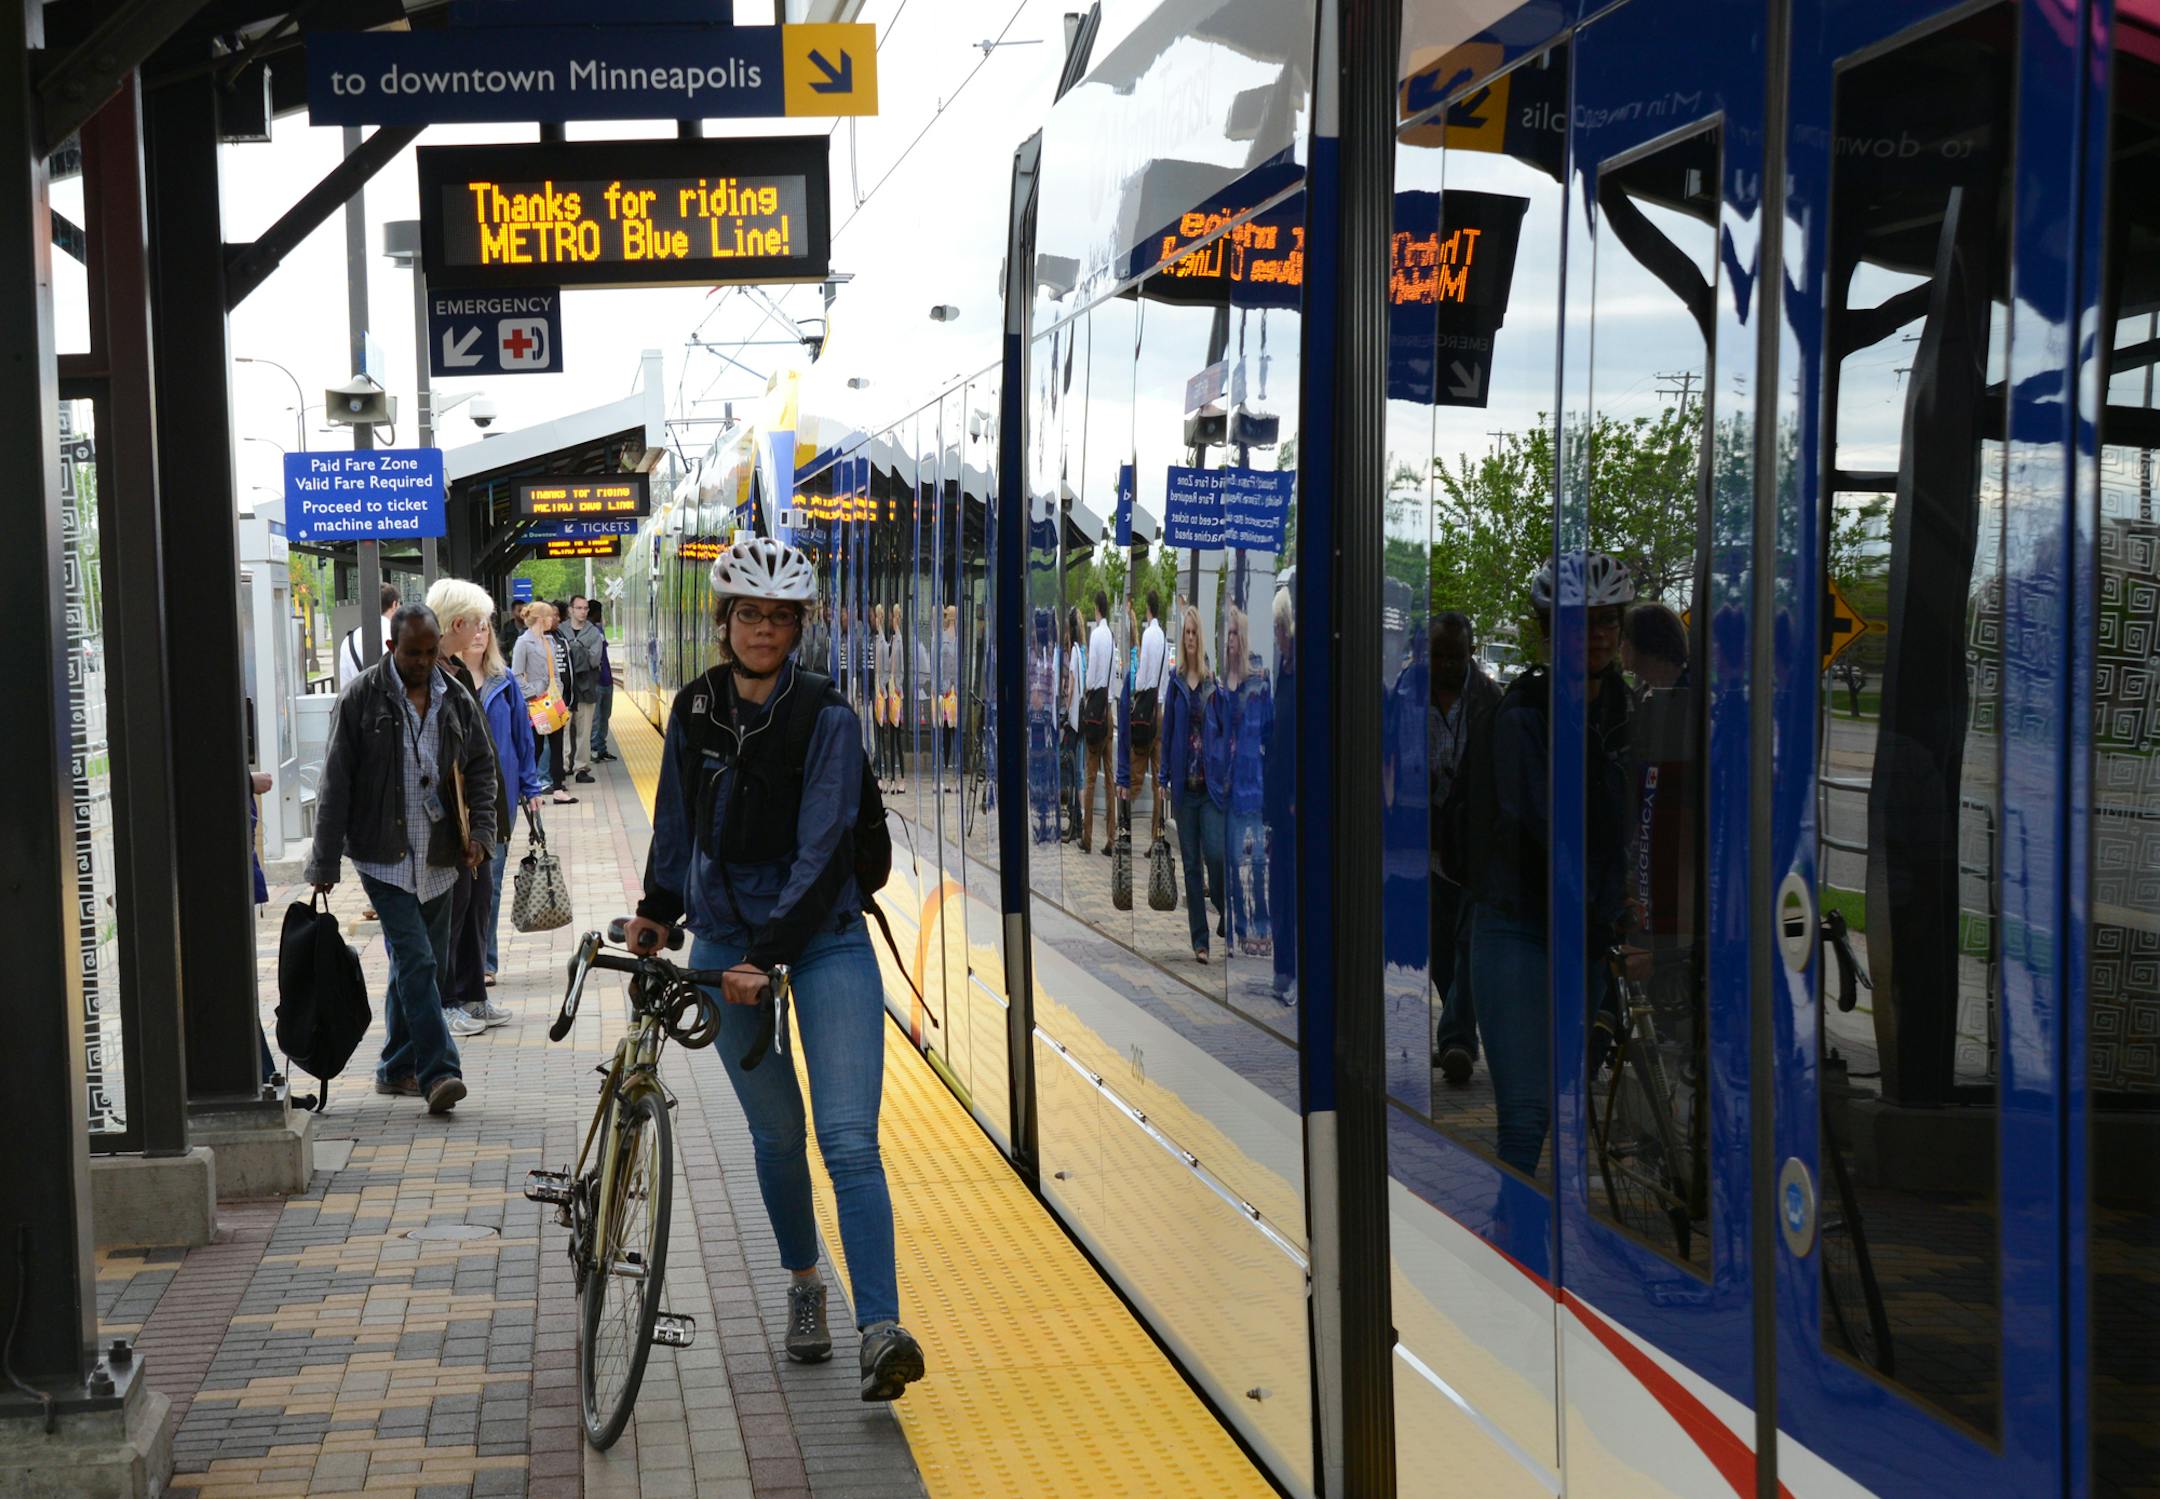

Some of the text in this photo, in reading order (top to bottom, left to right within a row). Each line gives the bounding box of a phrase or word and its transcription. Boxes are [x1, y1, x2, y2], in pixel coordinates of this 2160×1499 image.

[333, 57, 762, 98] to downtown Minneapolis
[469, 178, 778, 223] Thanks for riding
[480, 216, 790, 265] METRO Blue Line!
[435, 297, 553, 317] EMERGENCY
[311, 456, 418, 473] Paid Fare Zone
[296, 474, 433, 492] Valid Fare Required
[303, 498, 428, 514] Proceed to ticket
[313, 515, 419, 533] machine ahead
[581, 521, 630, 533] TICKETS
